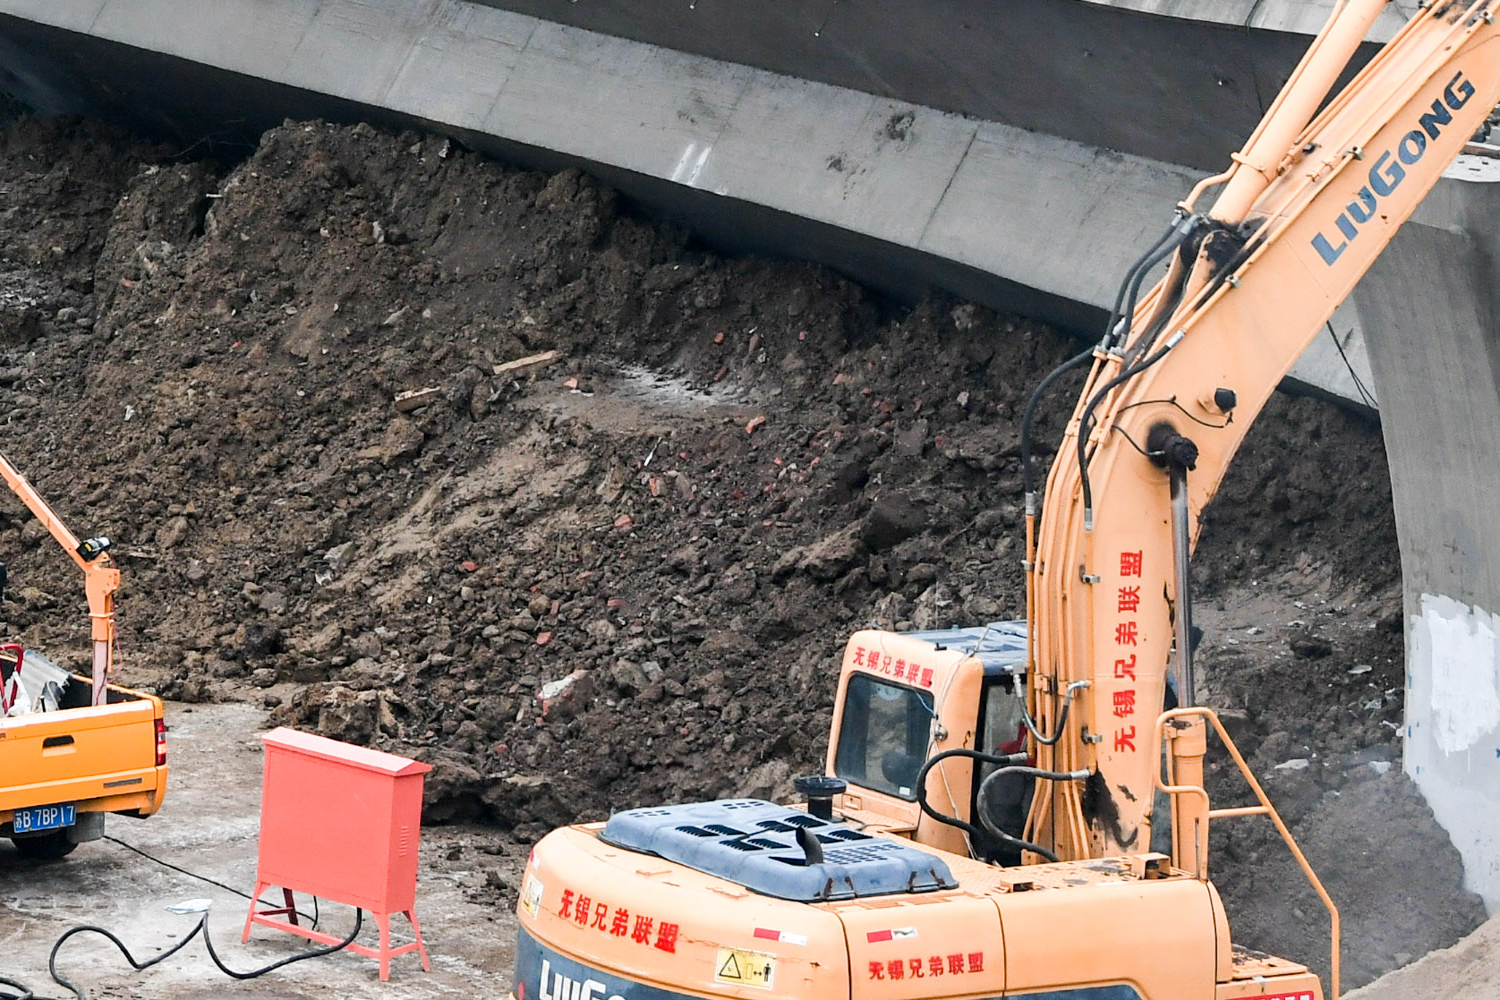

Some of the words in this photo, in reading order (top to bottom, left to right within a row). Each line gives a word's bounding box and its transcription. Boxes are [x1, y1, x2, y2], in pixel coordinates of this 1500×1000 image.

[1311, 70, 1476, 267] LIUGONG
[852, 646, 934, 688] 无锡兄弟联盟
[1112, 550, 1143, 753] 无锡兄弟联盟
[558, 889, 680, 954] 无锡兄弟联盟
[868, 951, 985, 981] 无锡兄弟联盟
